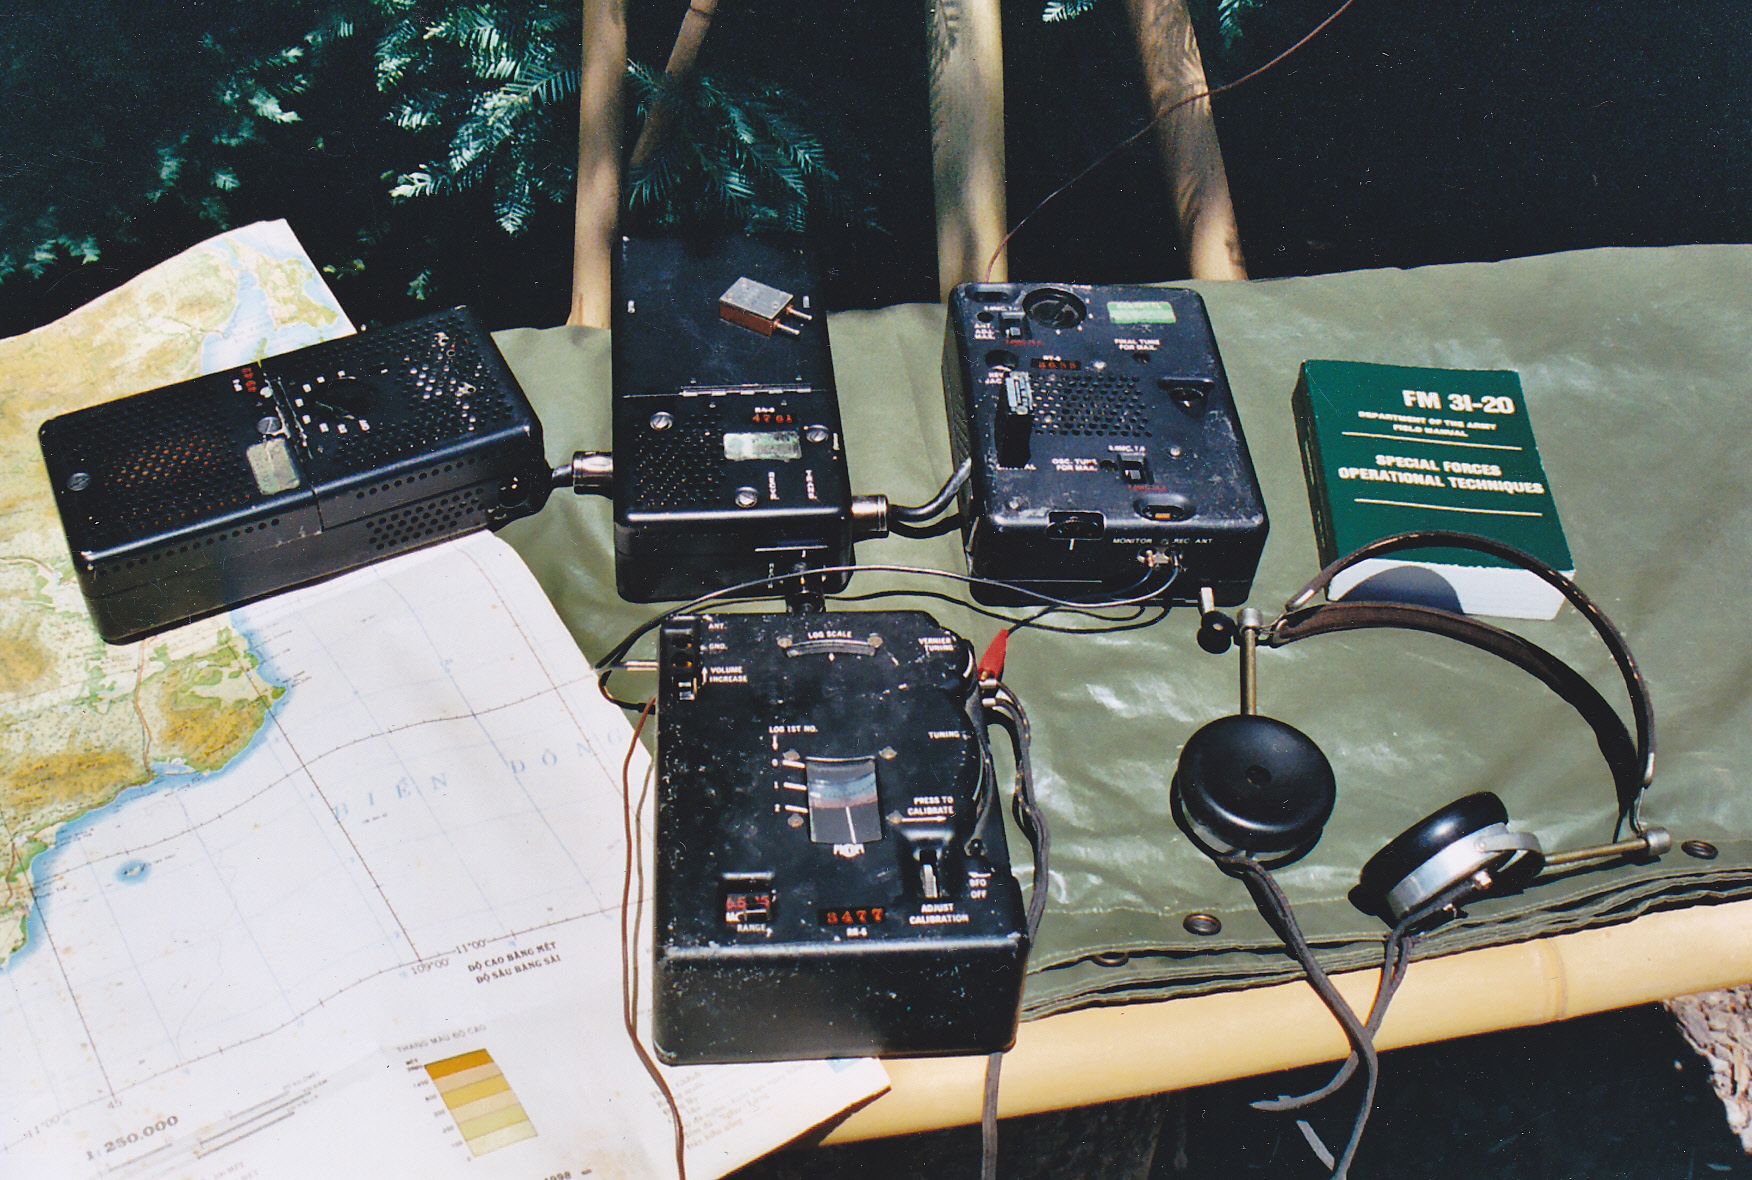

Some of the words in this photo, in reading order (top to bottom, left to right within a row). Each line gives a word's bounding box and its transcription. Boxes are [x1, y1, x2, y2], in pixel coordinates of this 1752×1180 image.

[1402, 389, 1442, 410] FM
[1358, 410, 1427, 425] DEPARTMENT
[1428, 417, 1443, 426] OF
[1443, 419, 1465, 429] THE
[1466, 421, 1497, 431] ARMY
[1393, 424, 1423, 434] FIELD
[1424, 427, 1469, 438] MANUAL
[1375, 454, 1441, 472] SPECIAL
[1443, 461, 1503, 477] FORCES
[1338, 467, 1446, 488] OPERATIONAL
[1447, 476, 1545, 495] TECHNIQUES
[708, 622, 727, 630] ANT.
[807, 630, 825, 640] LOG
[826, 629, 852, 639] SCALE
[708, 642, 728, 651] GND.
[710, 665, 743, 675] VOLUME
[709, 674, 748, 683] INCREASE
[768, 725, 783, 734] LOG
[927, 730, 960, 739] TUNING
[913, 795, 940, 806] PRESS
[941, 795, 955, 805] TO
[907, 804, 955, 817] CALIBRATE
[968, 878, 987, 889] BFO
[969, 888, 988, 900] OFF
[921, 902, 955, 914] ADJUST
[908, 913, 970, 926] CALIBRATION
[736, 922, 767, 933] RANGE
